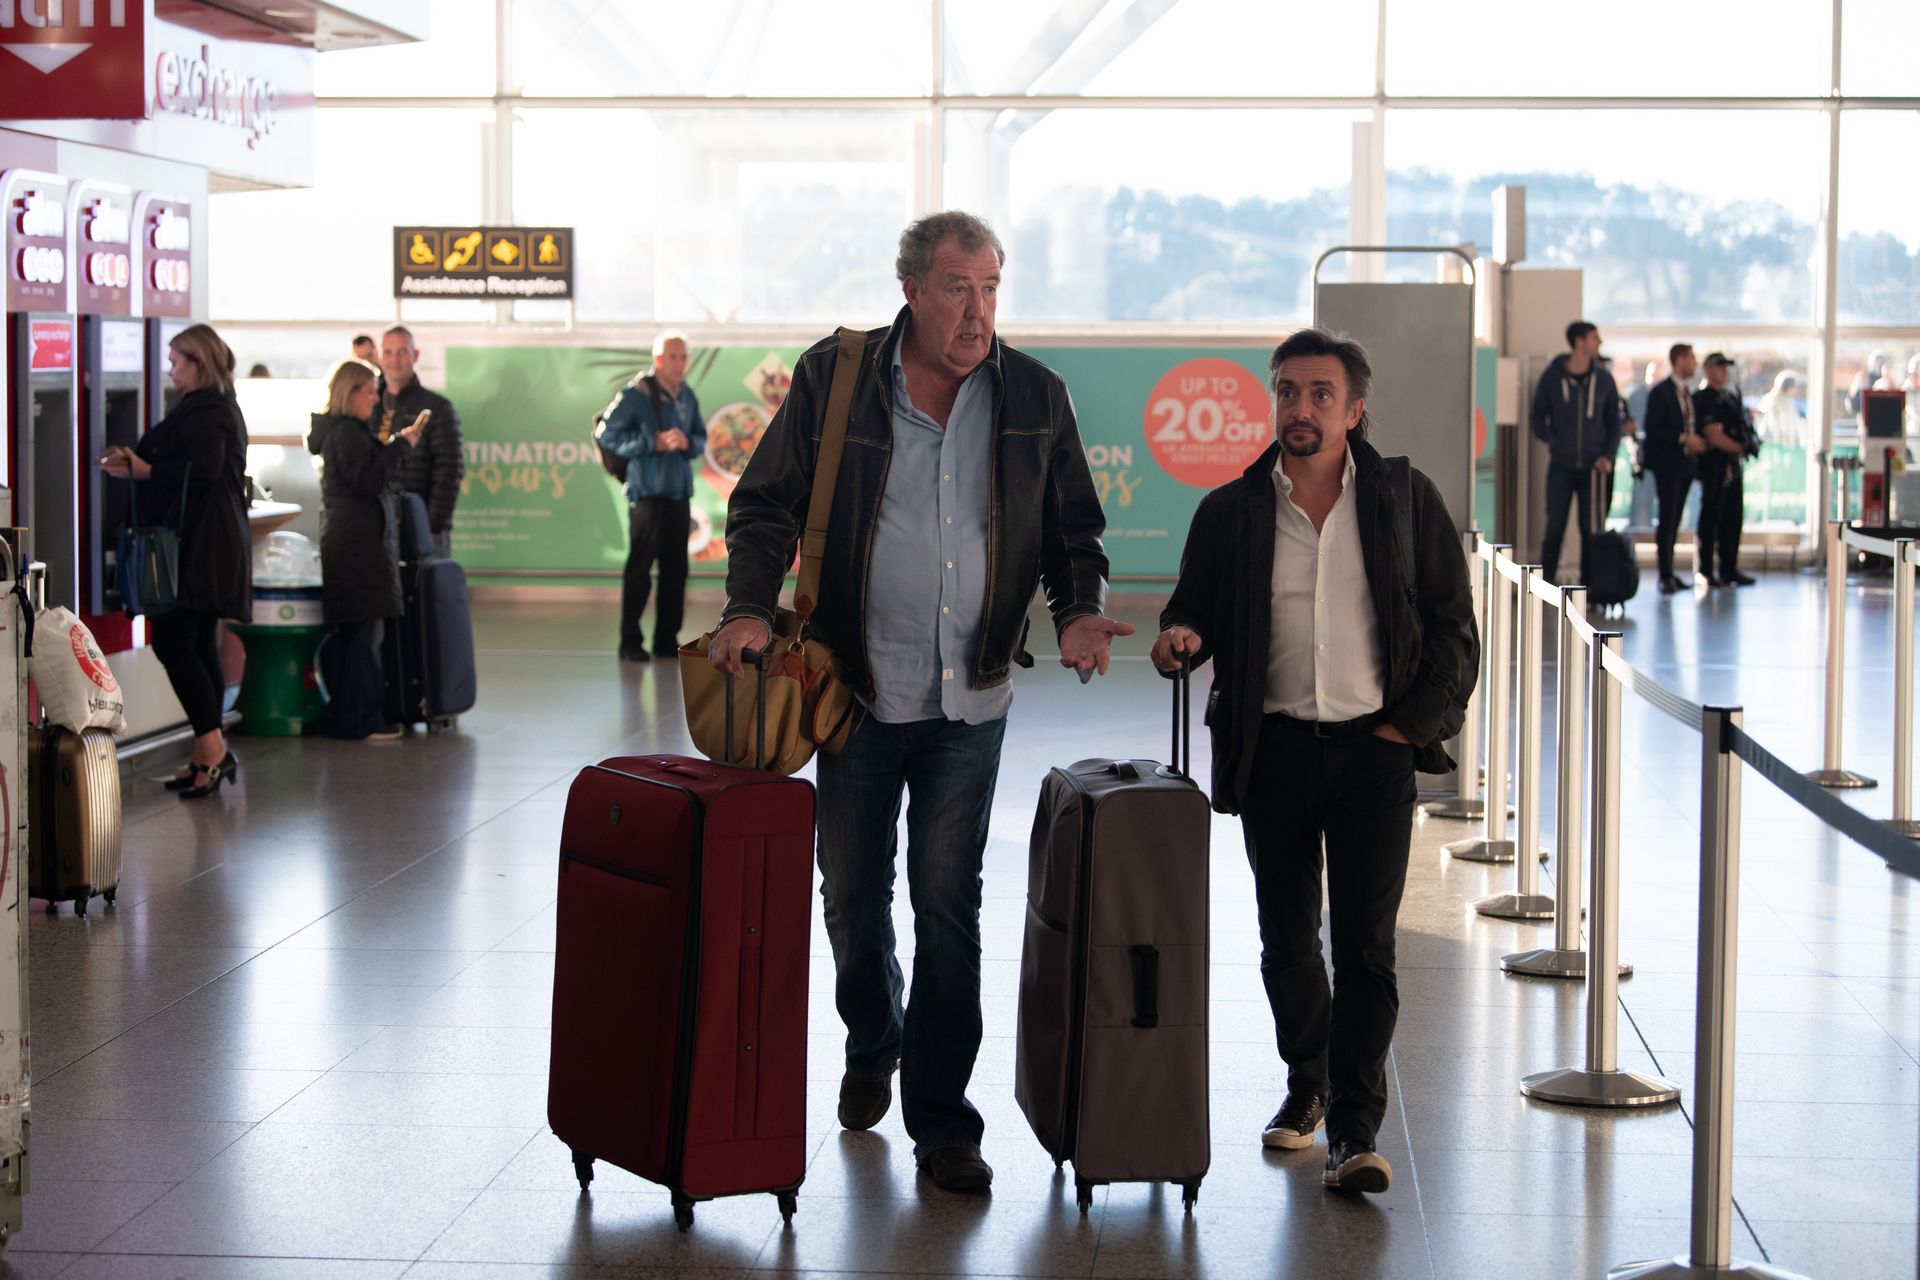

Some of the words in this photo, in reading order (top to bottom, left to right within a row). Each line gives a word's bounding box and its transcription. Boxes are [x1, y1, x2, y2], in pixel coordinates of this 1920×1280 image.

[156, 44, 276, 150] exchange
[400, 275, 486, 294] Assistance
[487, 275, 567, 297] Reception
[1180, 377, 1205, 394] UP
[1210, 377, 1238, 394] TO
[1225, 423, 1266, 441] OFF
[462, 441, 602, 465] TINATION
